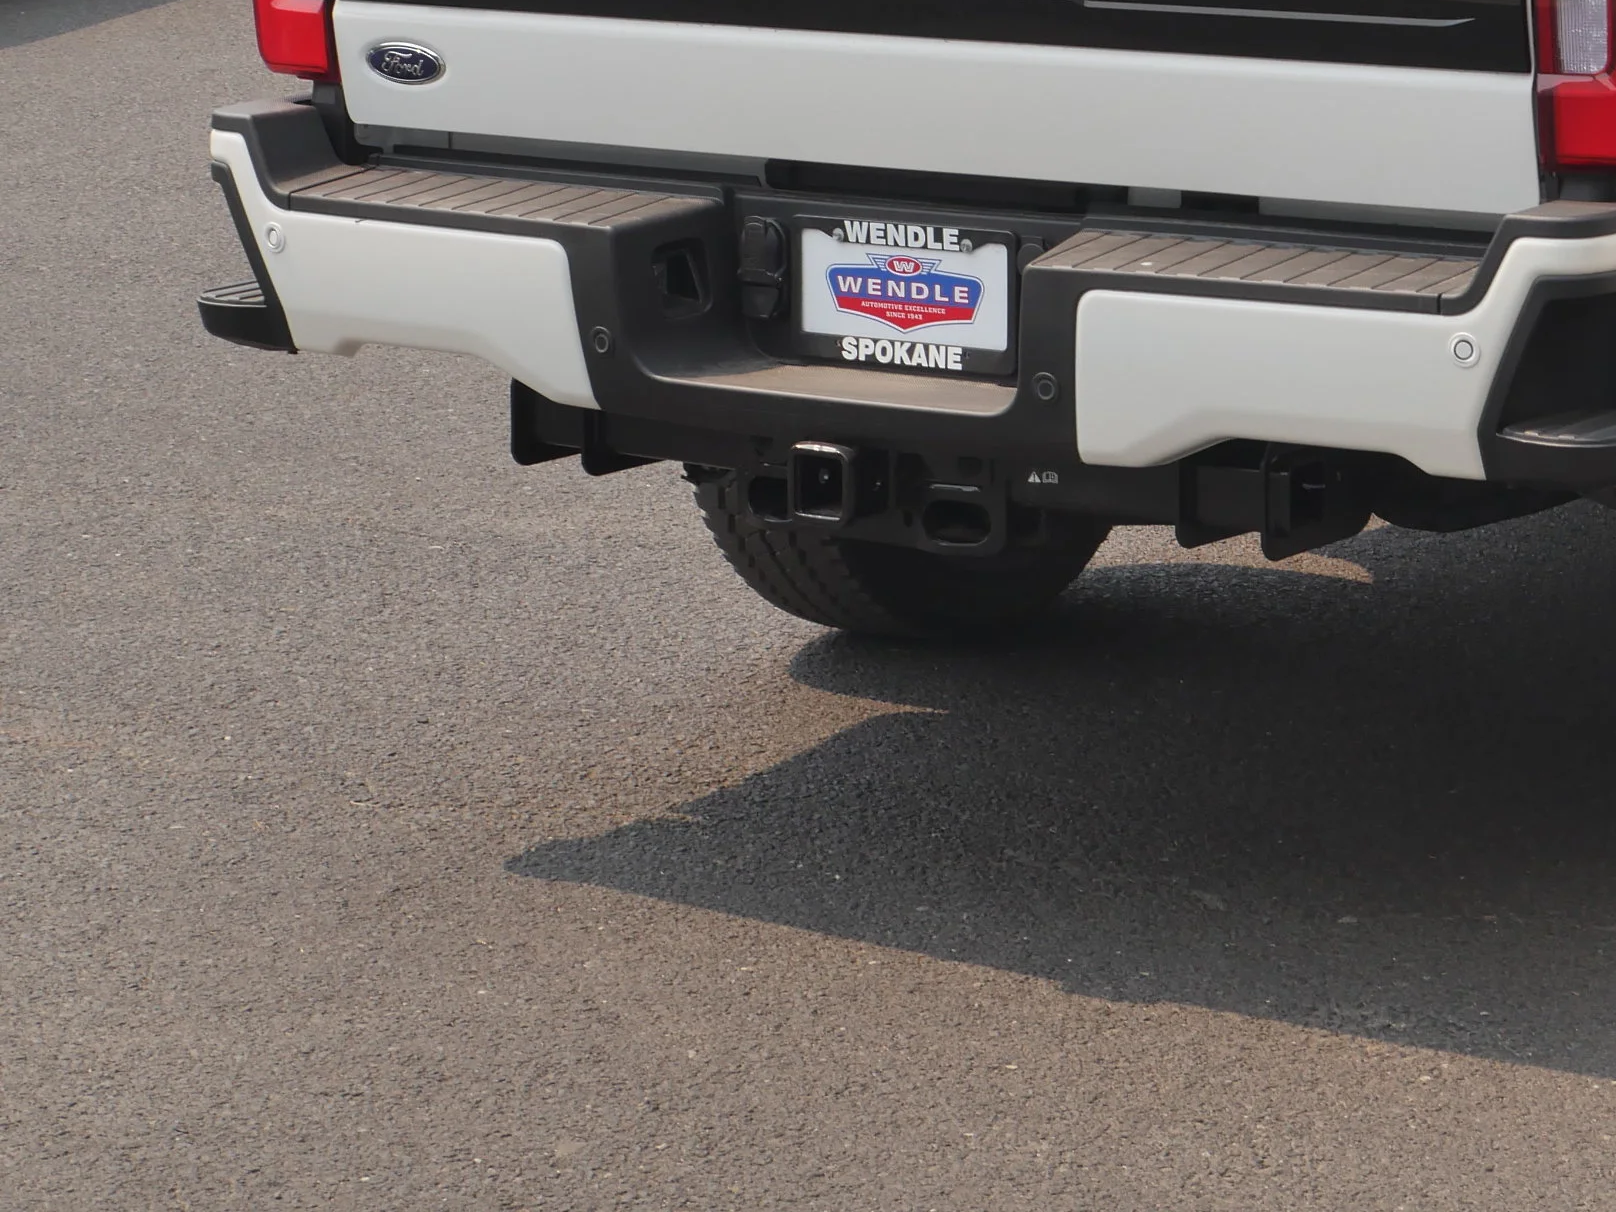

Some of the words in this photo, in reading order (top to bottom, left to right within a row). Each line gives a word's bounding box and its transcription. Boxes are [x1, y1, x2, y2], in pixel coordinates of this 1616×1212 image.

[381, 50, 424, 76] Ford
[844, 220, 961, 252] WENDLE
[836, 275, 970, 304] WENDLE
[861, 300, 903, 311] AUTOMOTIVE
[904, 304, 946, 315] EXCELLENCE
[885, 311, 906, 319] SINCE
[841, 336, 963, 371] SPOKANE
